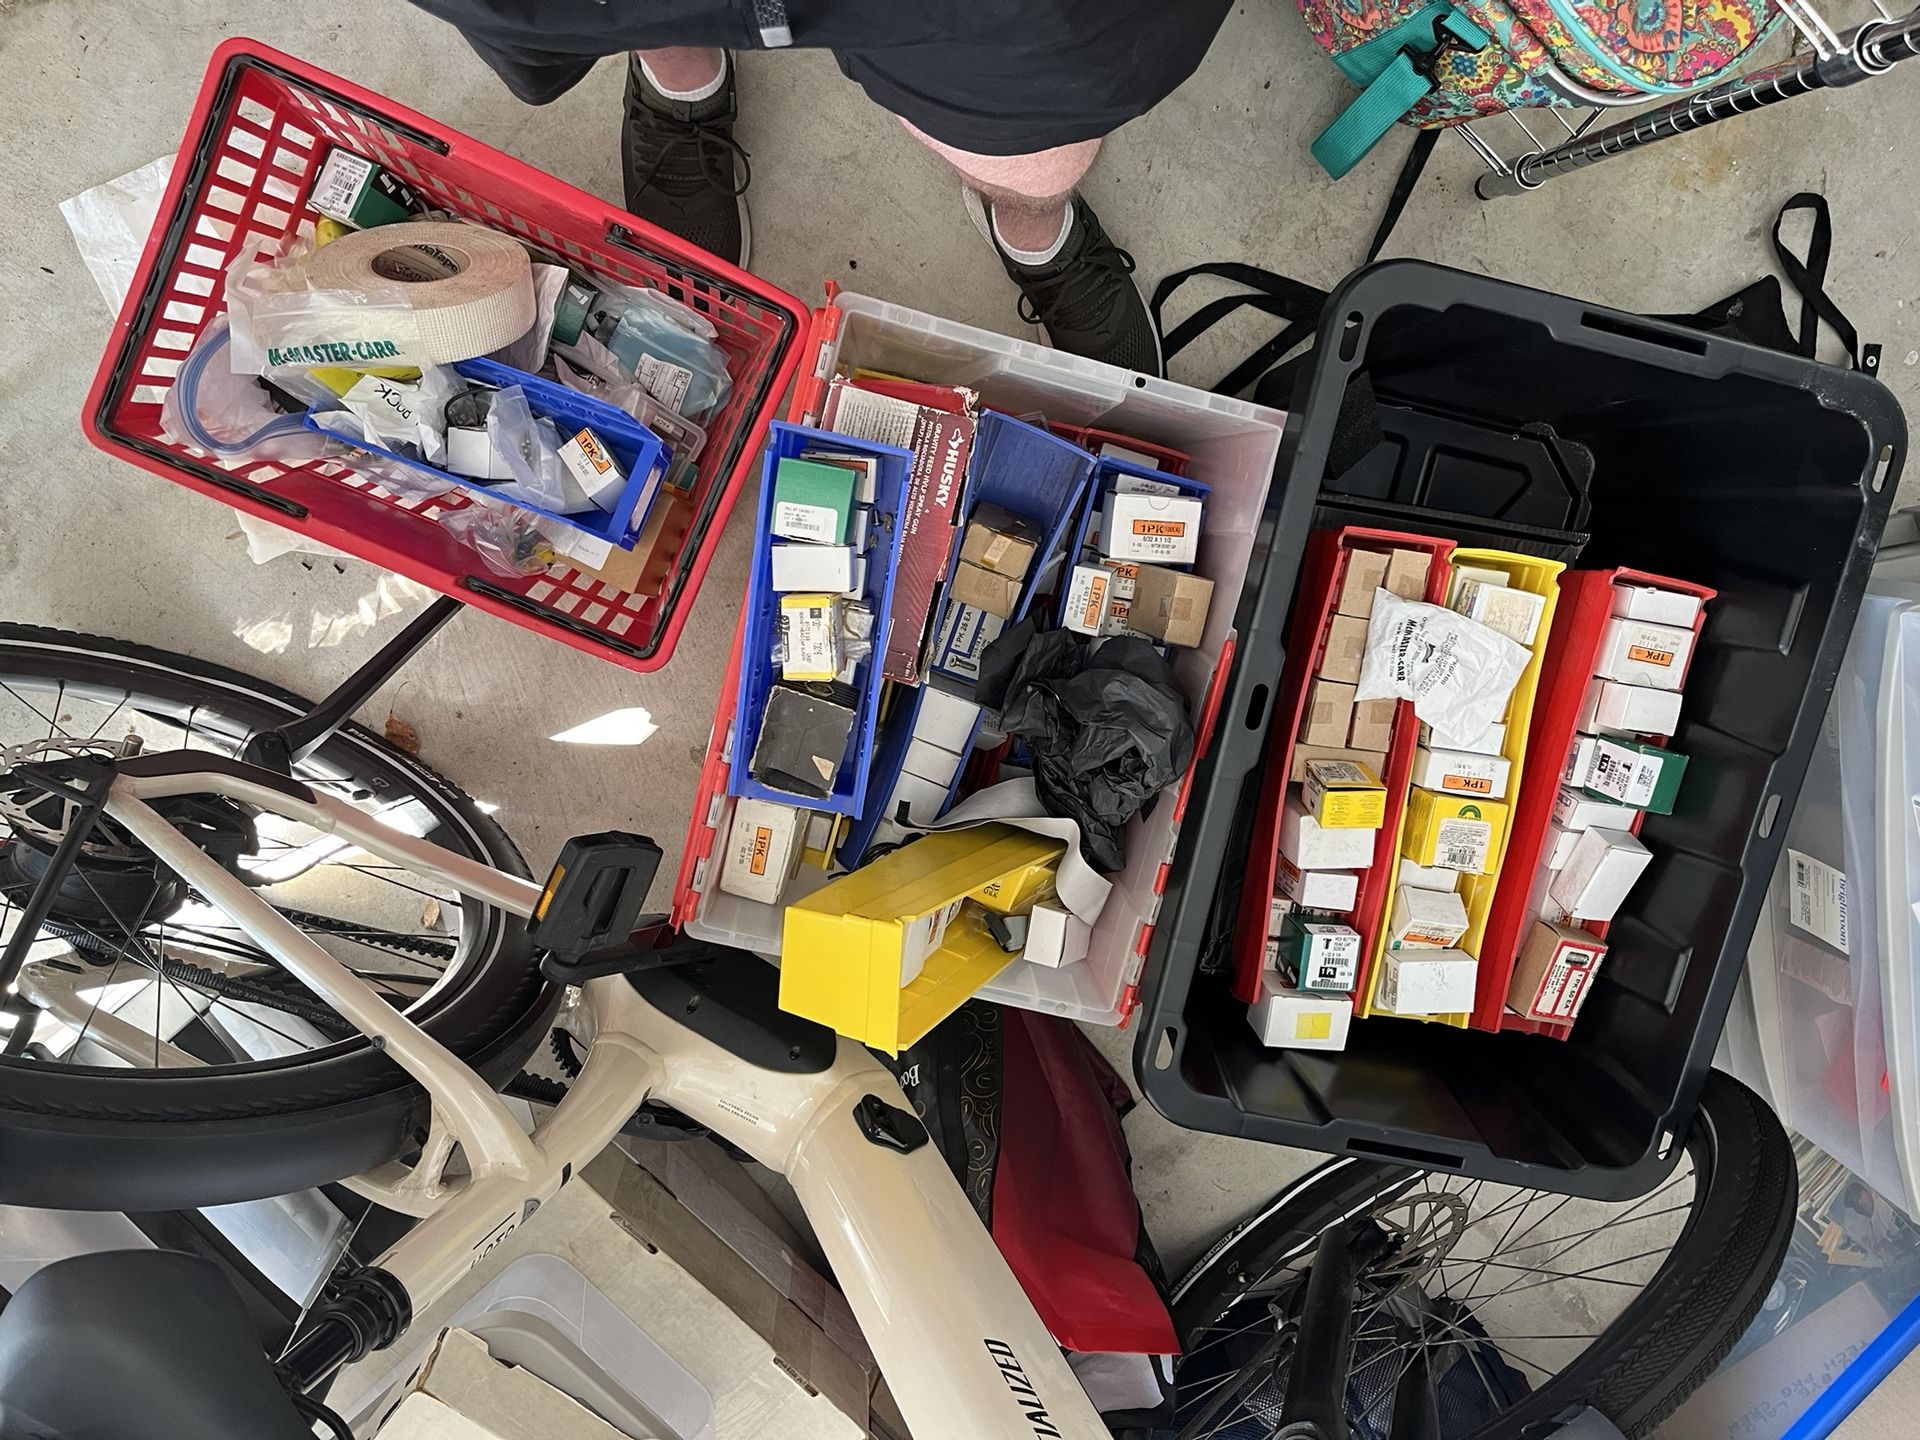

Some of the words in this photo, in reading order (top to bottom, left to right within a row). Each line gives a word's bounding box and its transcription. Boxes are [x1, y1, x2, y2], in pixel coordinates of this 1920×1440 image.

[579, 437, 597, 457] 1PK
[928, 423, 942, 454] GRAVITY
[924, 455, 934, 474] FEED
[919, 474, 929, 493] HVLP
[934, 448, 959, 507] HUSKY
[914, 494, 925, 517] SPRAY
[910, 518, 919, 535] GUN
[1140, 524, 1163, 533] 1PK
[1117, 567, 1132, 576] PK
[1089, 585, 1100, 608] 1PK
[956, 631, 965, 643] PK
[963, 610, 972, 621] EA
[1645, 650, 1664, 660] 1PK
[1462, 779, 1483, 788] 1PK
[755, 834, 766, 856] 1PK
[1838, 878, 1846, 945] brightroom
[1572, 978, 1580, 989] PK
[1563, 999, 1571, 1010] EA
[983, 1339, 1061, 1440] IALIZED
